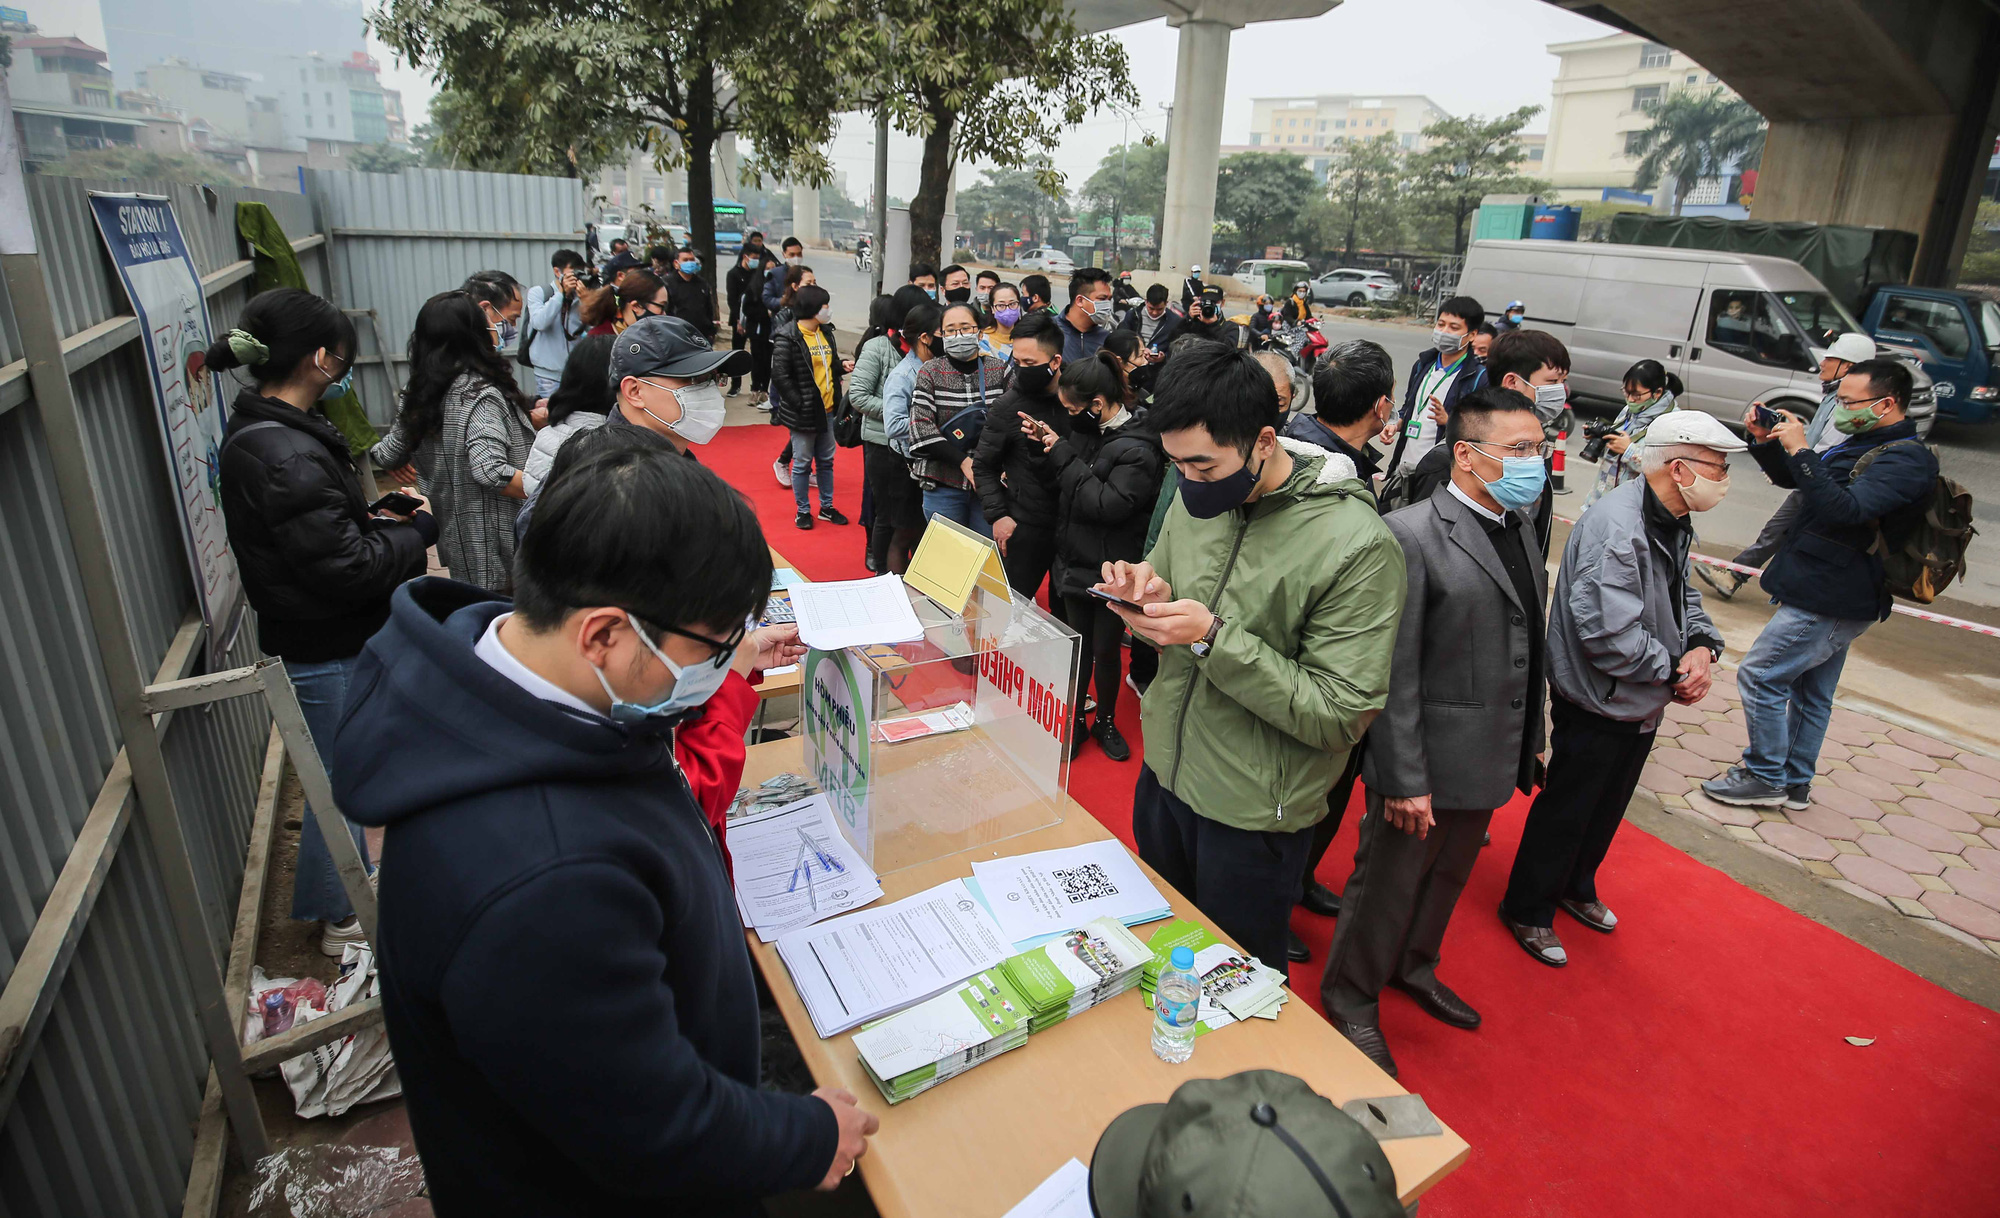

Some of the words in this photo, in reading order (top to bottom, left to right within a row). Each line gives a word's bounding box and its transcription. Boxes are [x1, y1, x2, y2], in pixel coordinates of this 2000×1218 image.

[814, 677, 831, 709] HÒM
[831, 698, 856, 737] PHIẾU
[814, 748, 856, 829] MRB
